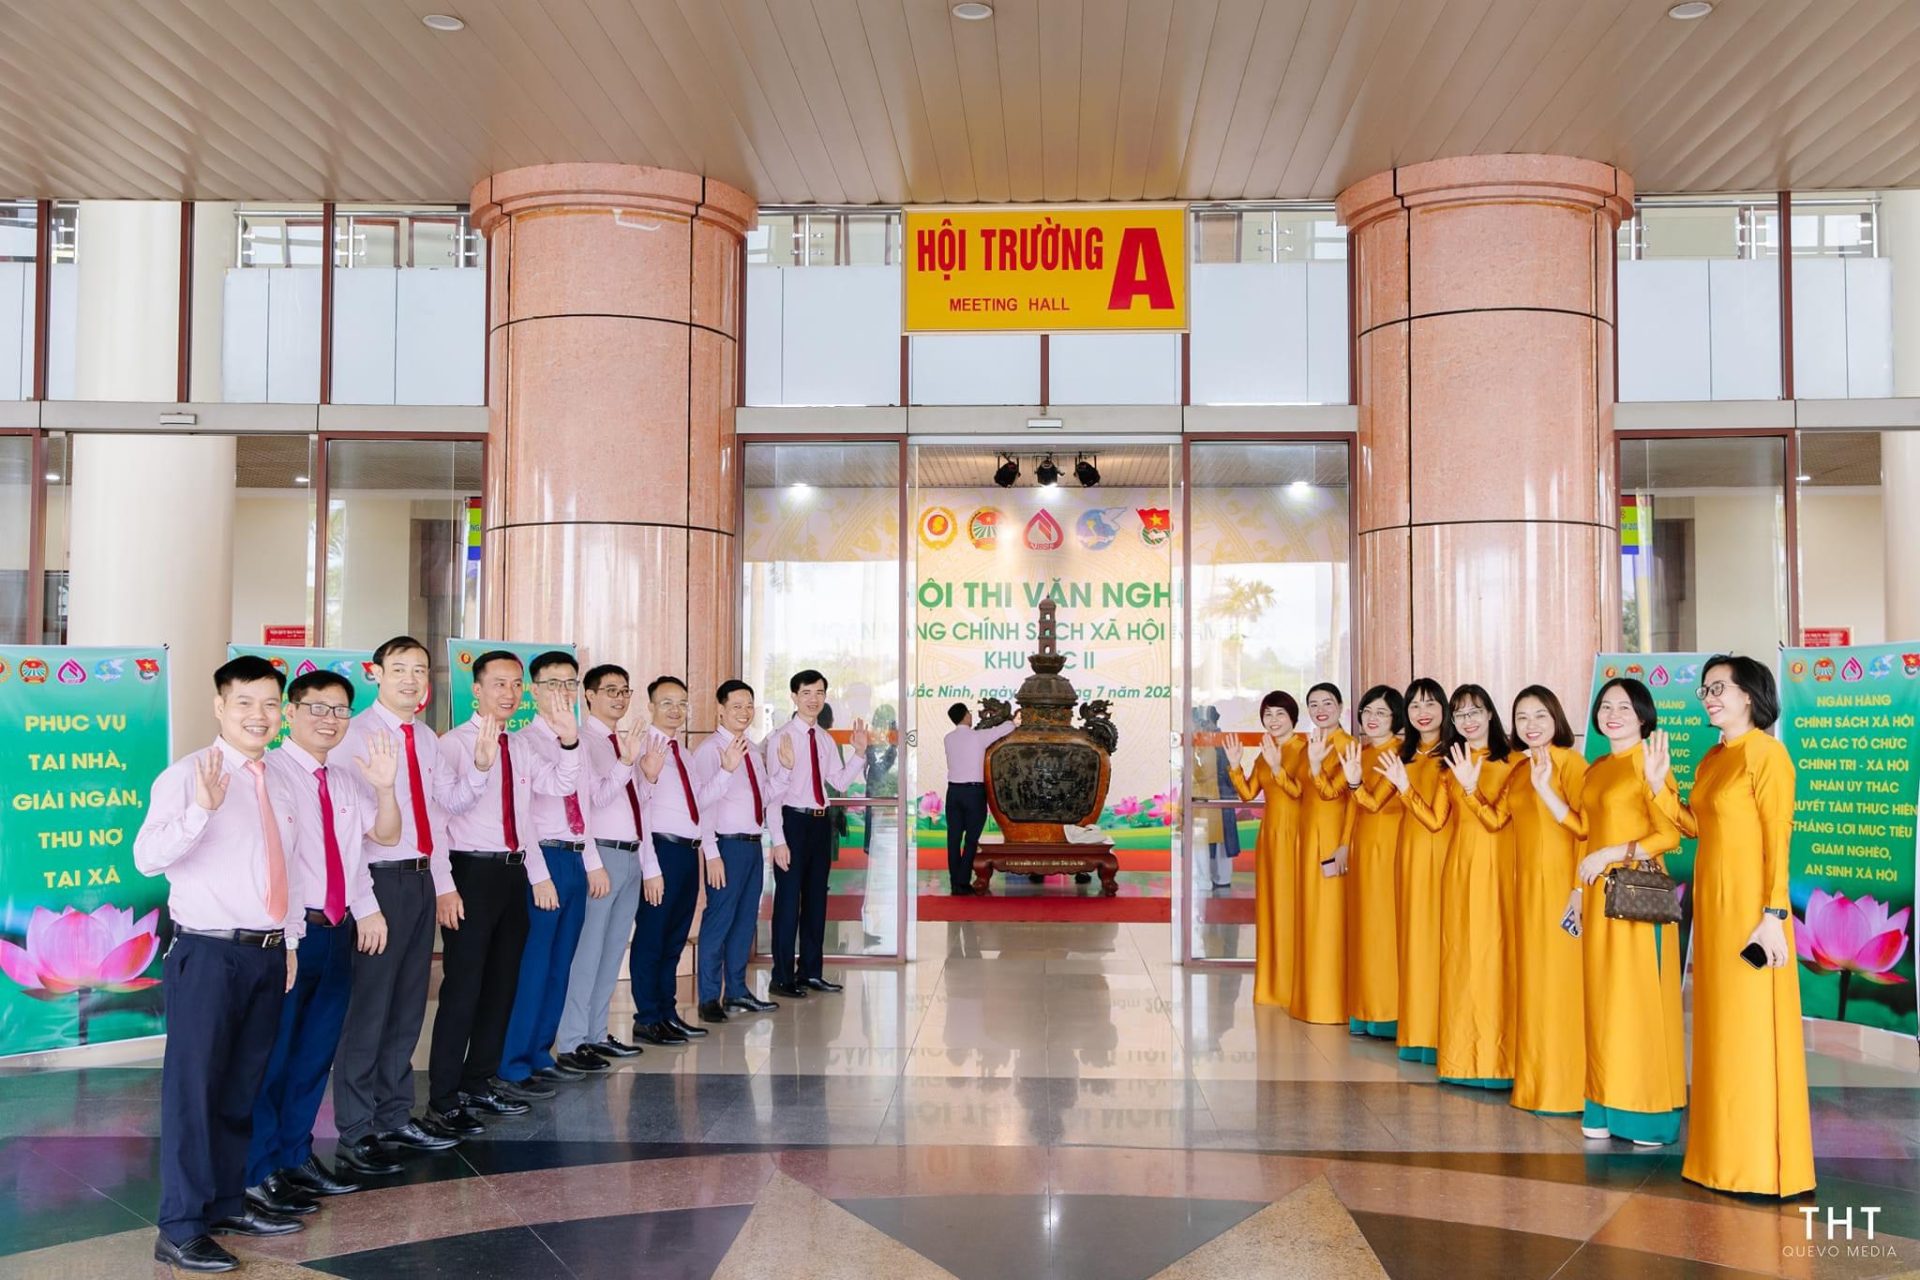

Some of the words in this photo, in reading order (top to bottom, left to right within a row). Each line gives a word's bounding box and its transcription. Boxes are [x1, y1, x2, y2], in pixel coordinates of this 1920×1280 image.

[917, 218, 967, 281] HỘI
[980, 216, 1104, 271] TRƯỜNG
[1107, 227, 1175, 310] A
[950, 298, 1018, 312] MEETING
[1028, 297, 1070, 311] HALL
[917, 577, 953, 611] ỘI
[963, 582, 1012, 608] THI
[1023, 577, 1092, 609] VĂN
[917, 622, 947, 641] NG
[952, 616, 1019, 641] CHÍNH
[1026, 622, 1084, 641] SCH
[1090, 618, 1121, 641] XÃ
[1127, 618, 1165, 645] HỘI
[985, 651, 1025, 669] KHU
[1084, 651, 1095, 669] II
[938, 685, 975, 699] Ninh,
[980, 686, 1017, 700] ngày
[1096, 686, 1105, 698] 7
[1108, 686, 1140, 698] năm
[1144, 686, 1171, 698] 202
[25, 714, 90, 733] PHỤC
[96, 714, 127, 732] VỤ
[1834, 714, 1869, 728] SÁCH
[1820, 736, 1849, 749] CÁC
[28, 753, 66, 771] TẠI
[72, 750, 127, 771] NHÀ,
[12, 790, 64, 811] GIẢI
[70, 788, 143, 809] NGÂN,
[38, 831, 83, 849] THU
[89, 828, 124, 847] NỢ
[44, 870, 81, 888] TẠI
[1804, 863, 1823, 875] AN
[1825, 865, 1853, 877] SINH
